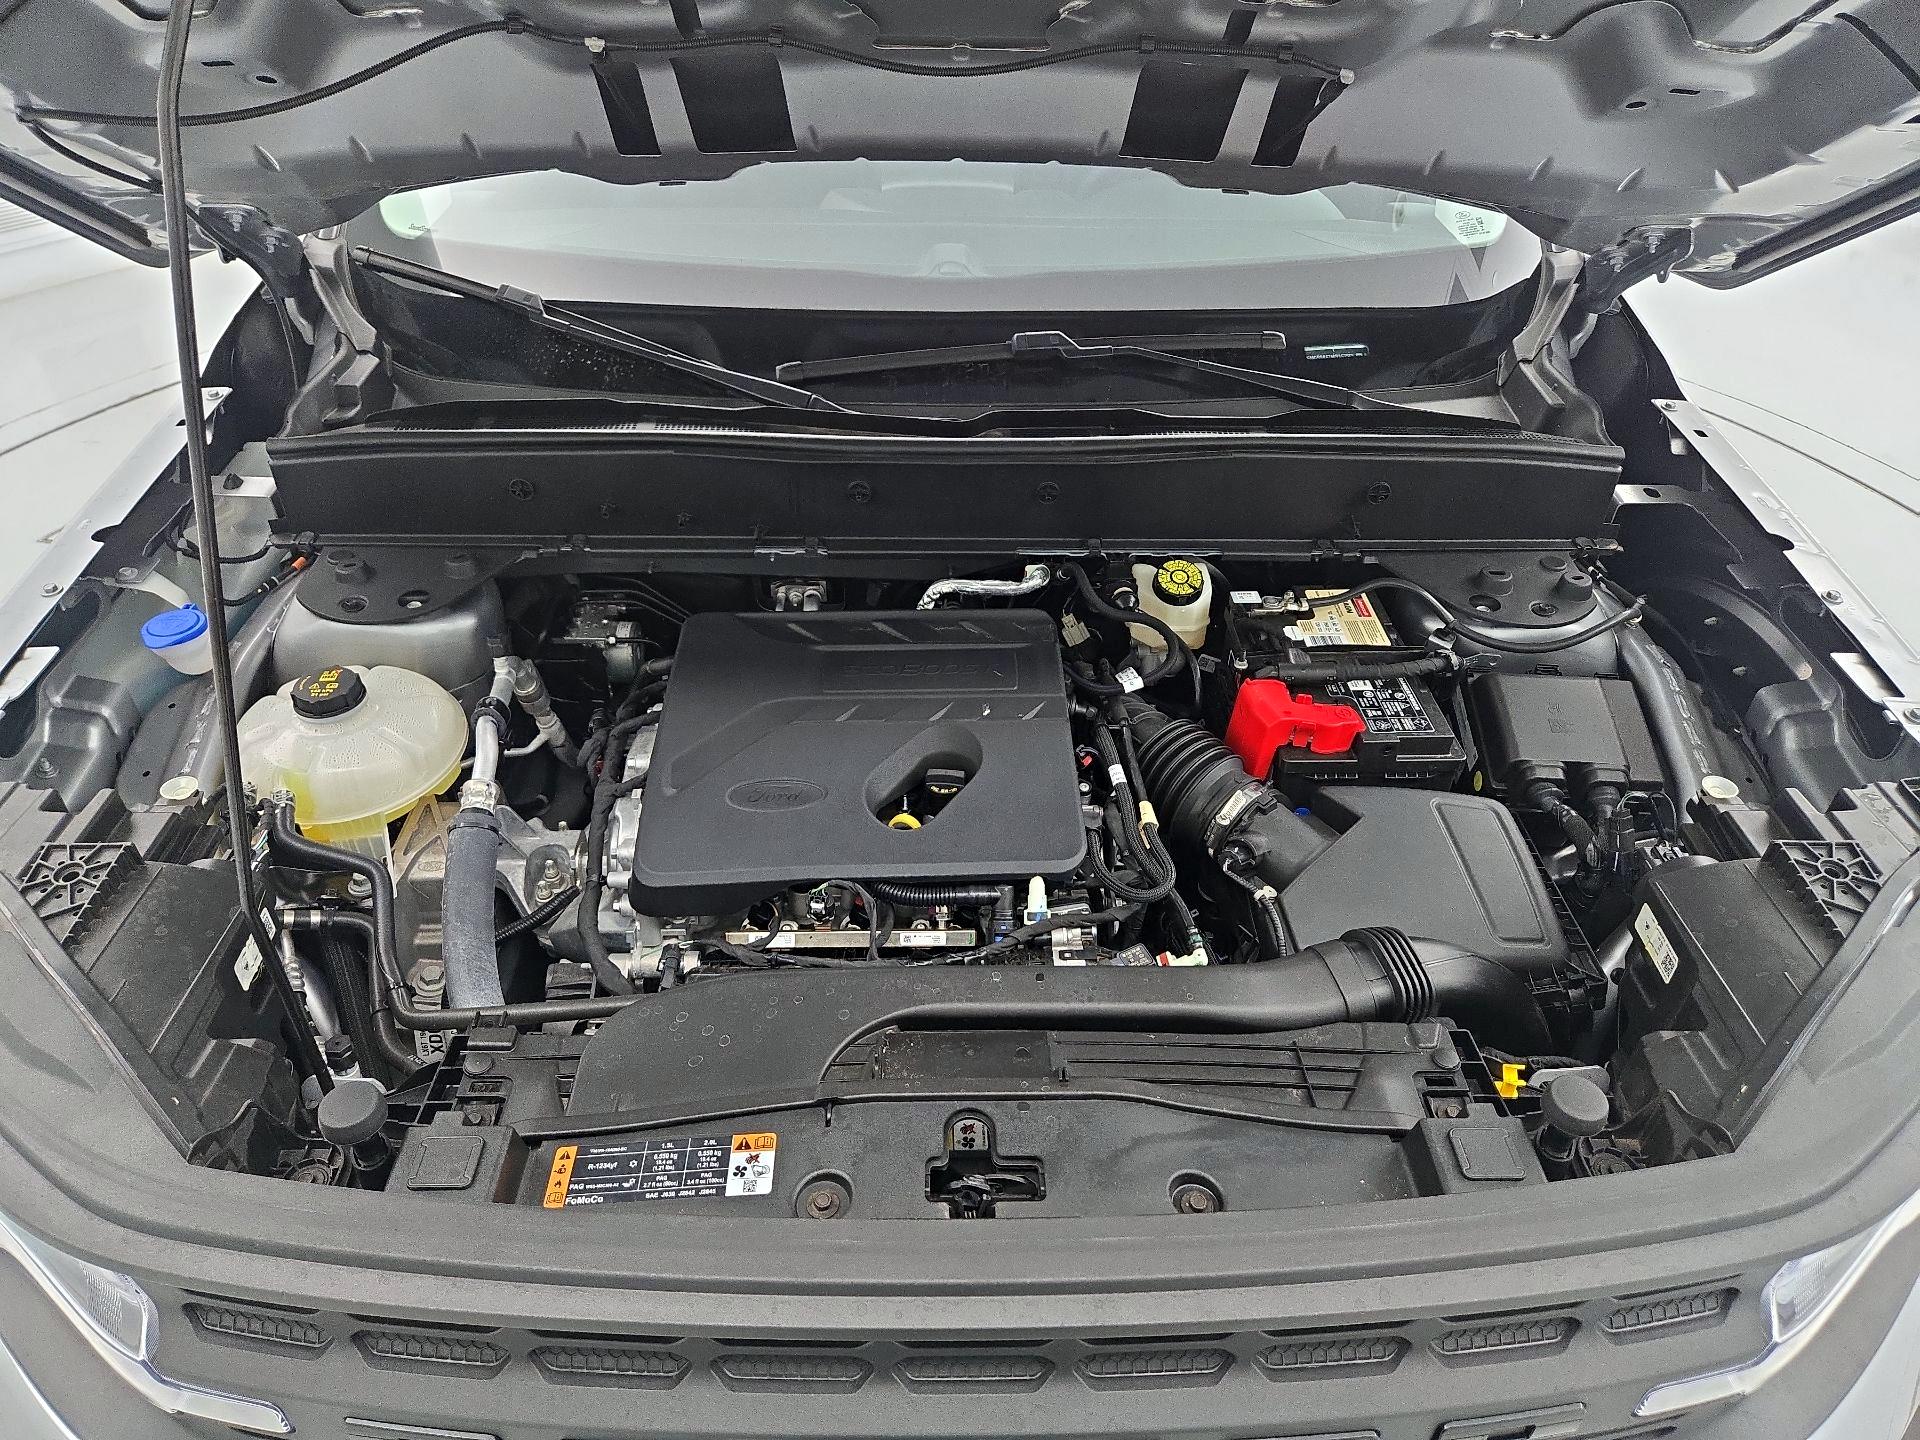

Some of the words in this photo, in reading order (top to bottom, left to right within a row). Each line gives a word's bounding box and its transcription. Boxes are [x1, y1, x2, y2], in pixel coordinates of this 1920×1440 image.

[429, 1031, 446, 1055] XD
[670, 1152, 678, 1160] kg
[587, 1161, 618, 1170] R-1234yf
[565, 1195, 604, 1205] FoMoCo
